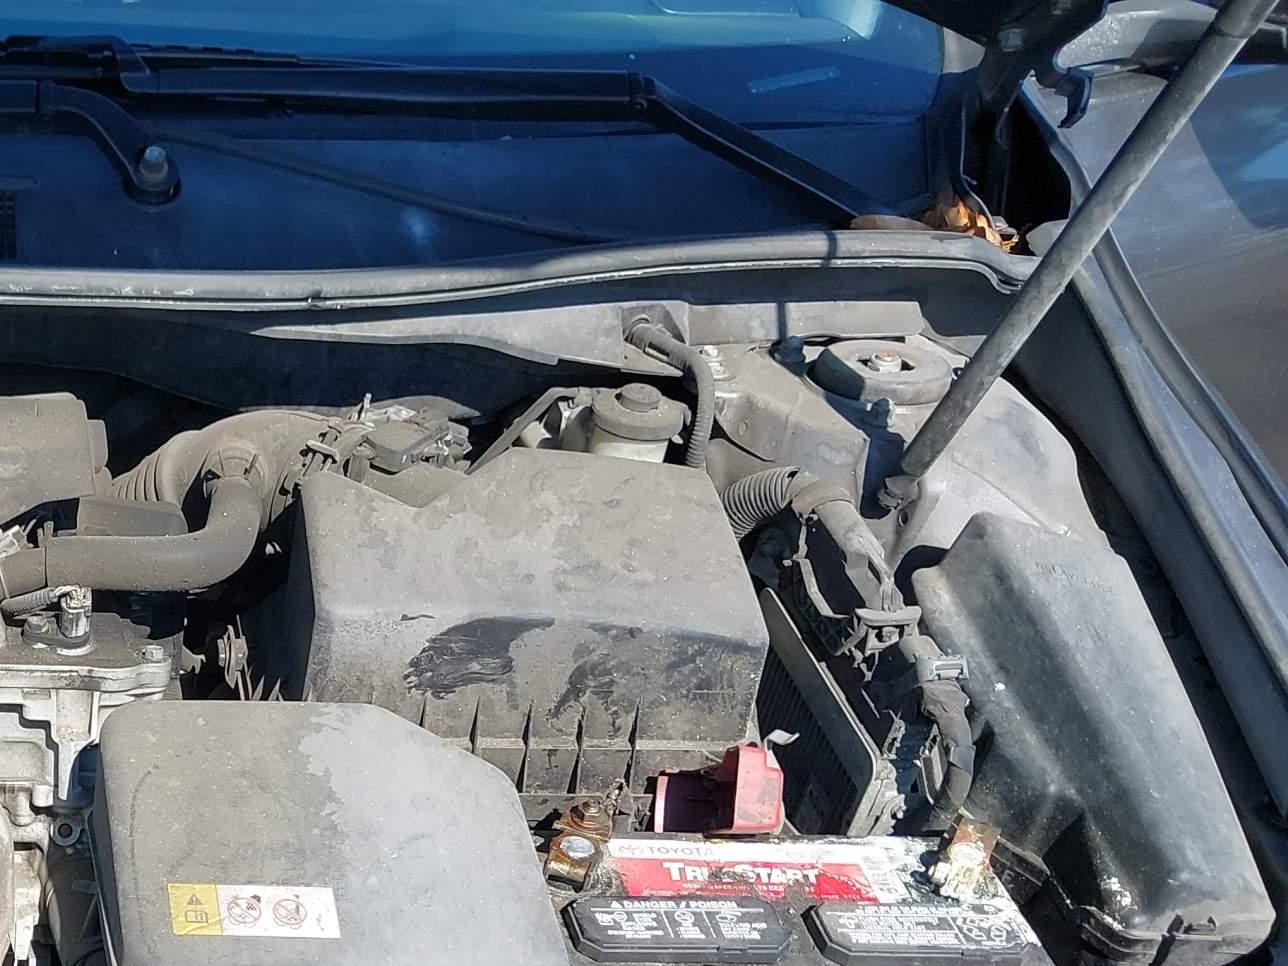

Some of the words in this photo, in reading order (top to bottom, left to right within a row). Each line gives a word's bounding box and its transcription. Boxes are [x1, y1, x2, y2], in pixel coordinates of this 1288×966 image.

[646, 845, 713, 857] TOYOTA
[663, 861, 819, 886] TRSTART
[623, 900, 678, 909] DANGER
[688, 900, 738, 909] POISON
